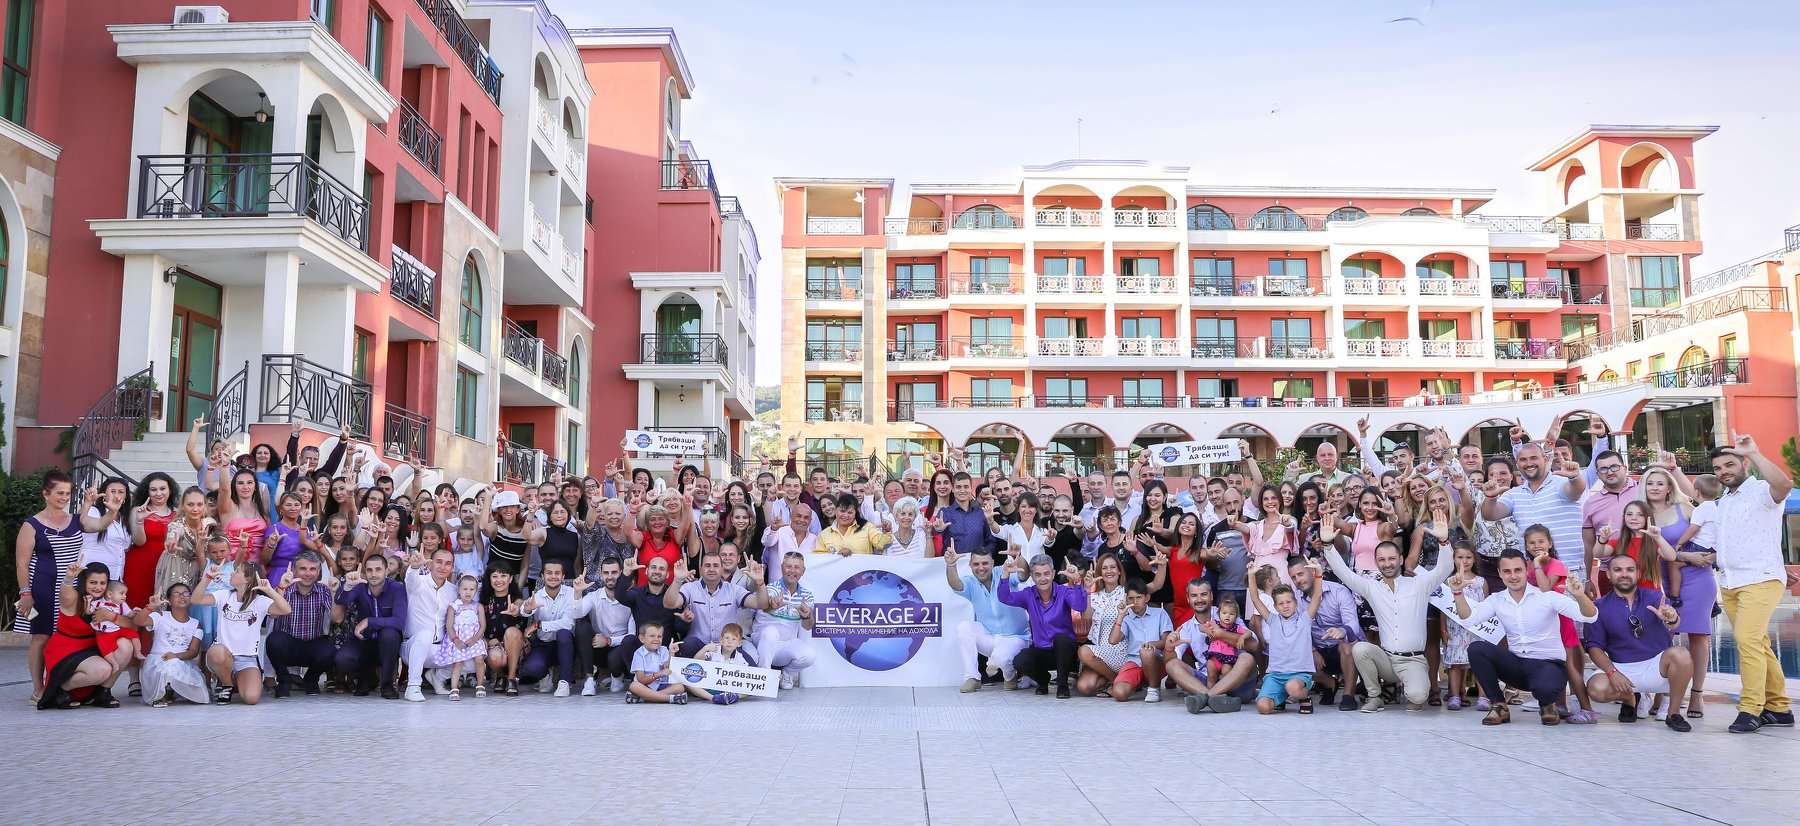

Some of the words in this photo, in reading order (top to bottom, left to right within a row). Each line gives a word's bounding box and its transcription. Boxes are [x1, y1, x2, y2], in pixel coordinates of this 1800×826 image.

[658, 435, 697, 444] Трябваше
[1185, 444, 1229, 453] Трябваше
[1214, 450, 1230, 459] тук!
[815, 607, 914, 624] LEVERAGE
[920, 606, 938, 623] 21
[1474, 624, 1495, 634] ук!
[715, 667, 767, 681] Трябваше
[746, 682, 765, 692] тук!
